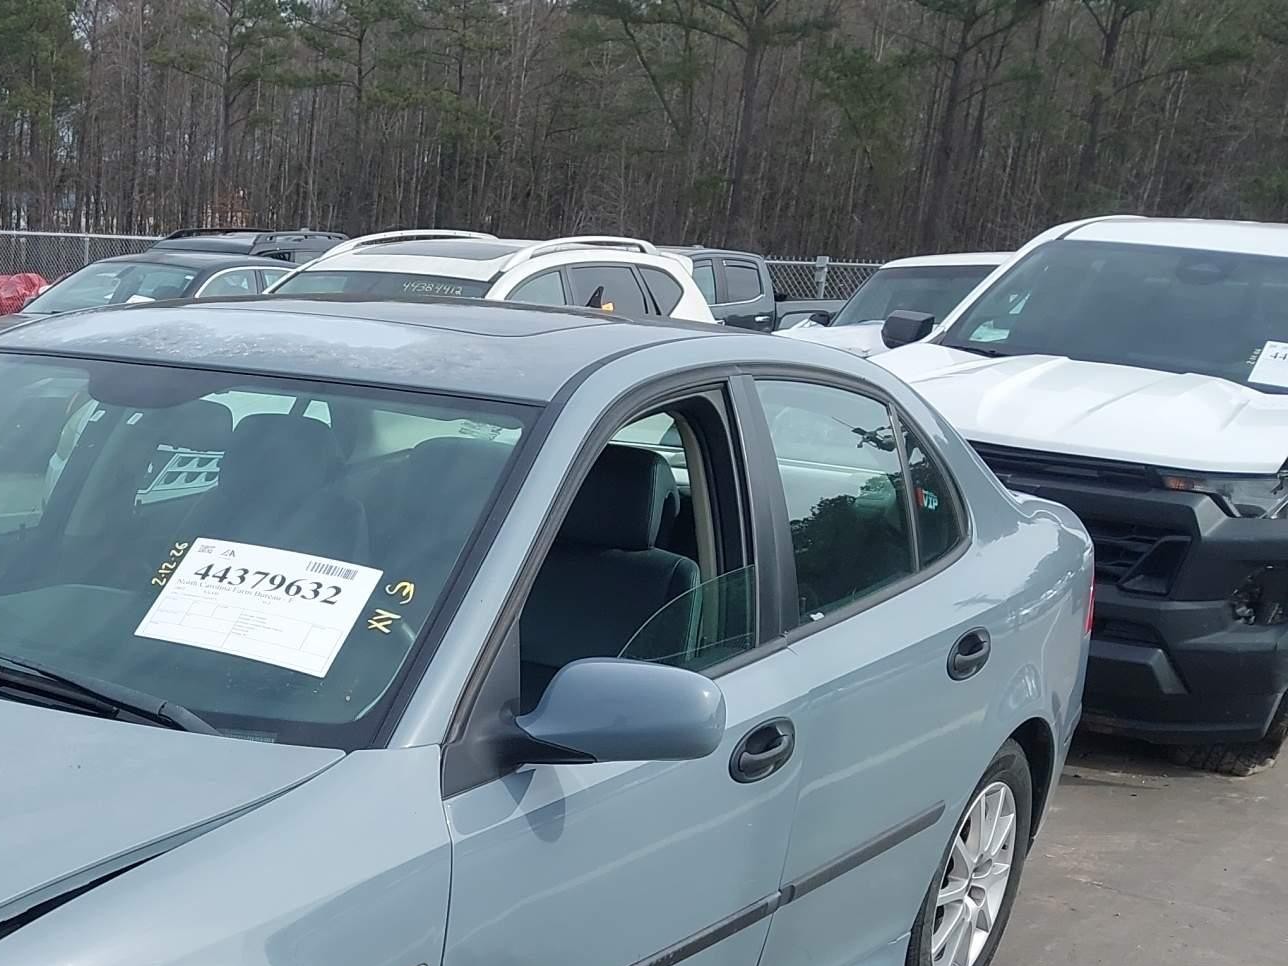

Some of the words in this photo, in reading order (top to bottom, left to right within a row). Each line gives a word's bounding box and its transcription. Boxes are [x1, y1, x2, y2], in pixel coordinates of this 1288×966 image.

[922, 489, 939, 510] VIP
[194, 563, 344, 605] 44379632
[199, 580, 231, 592] Carolina
